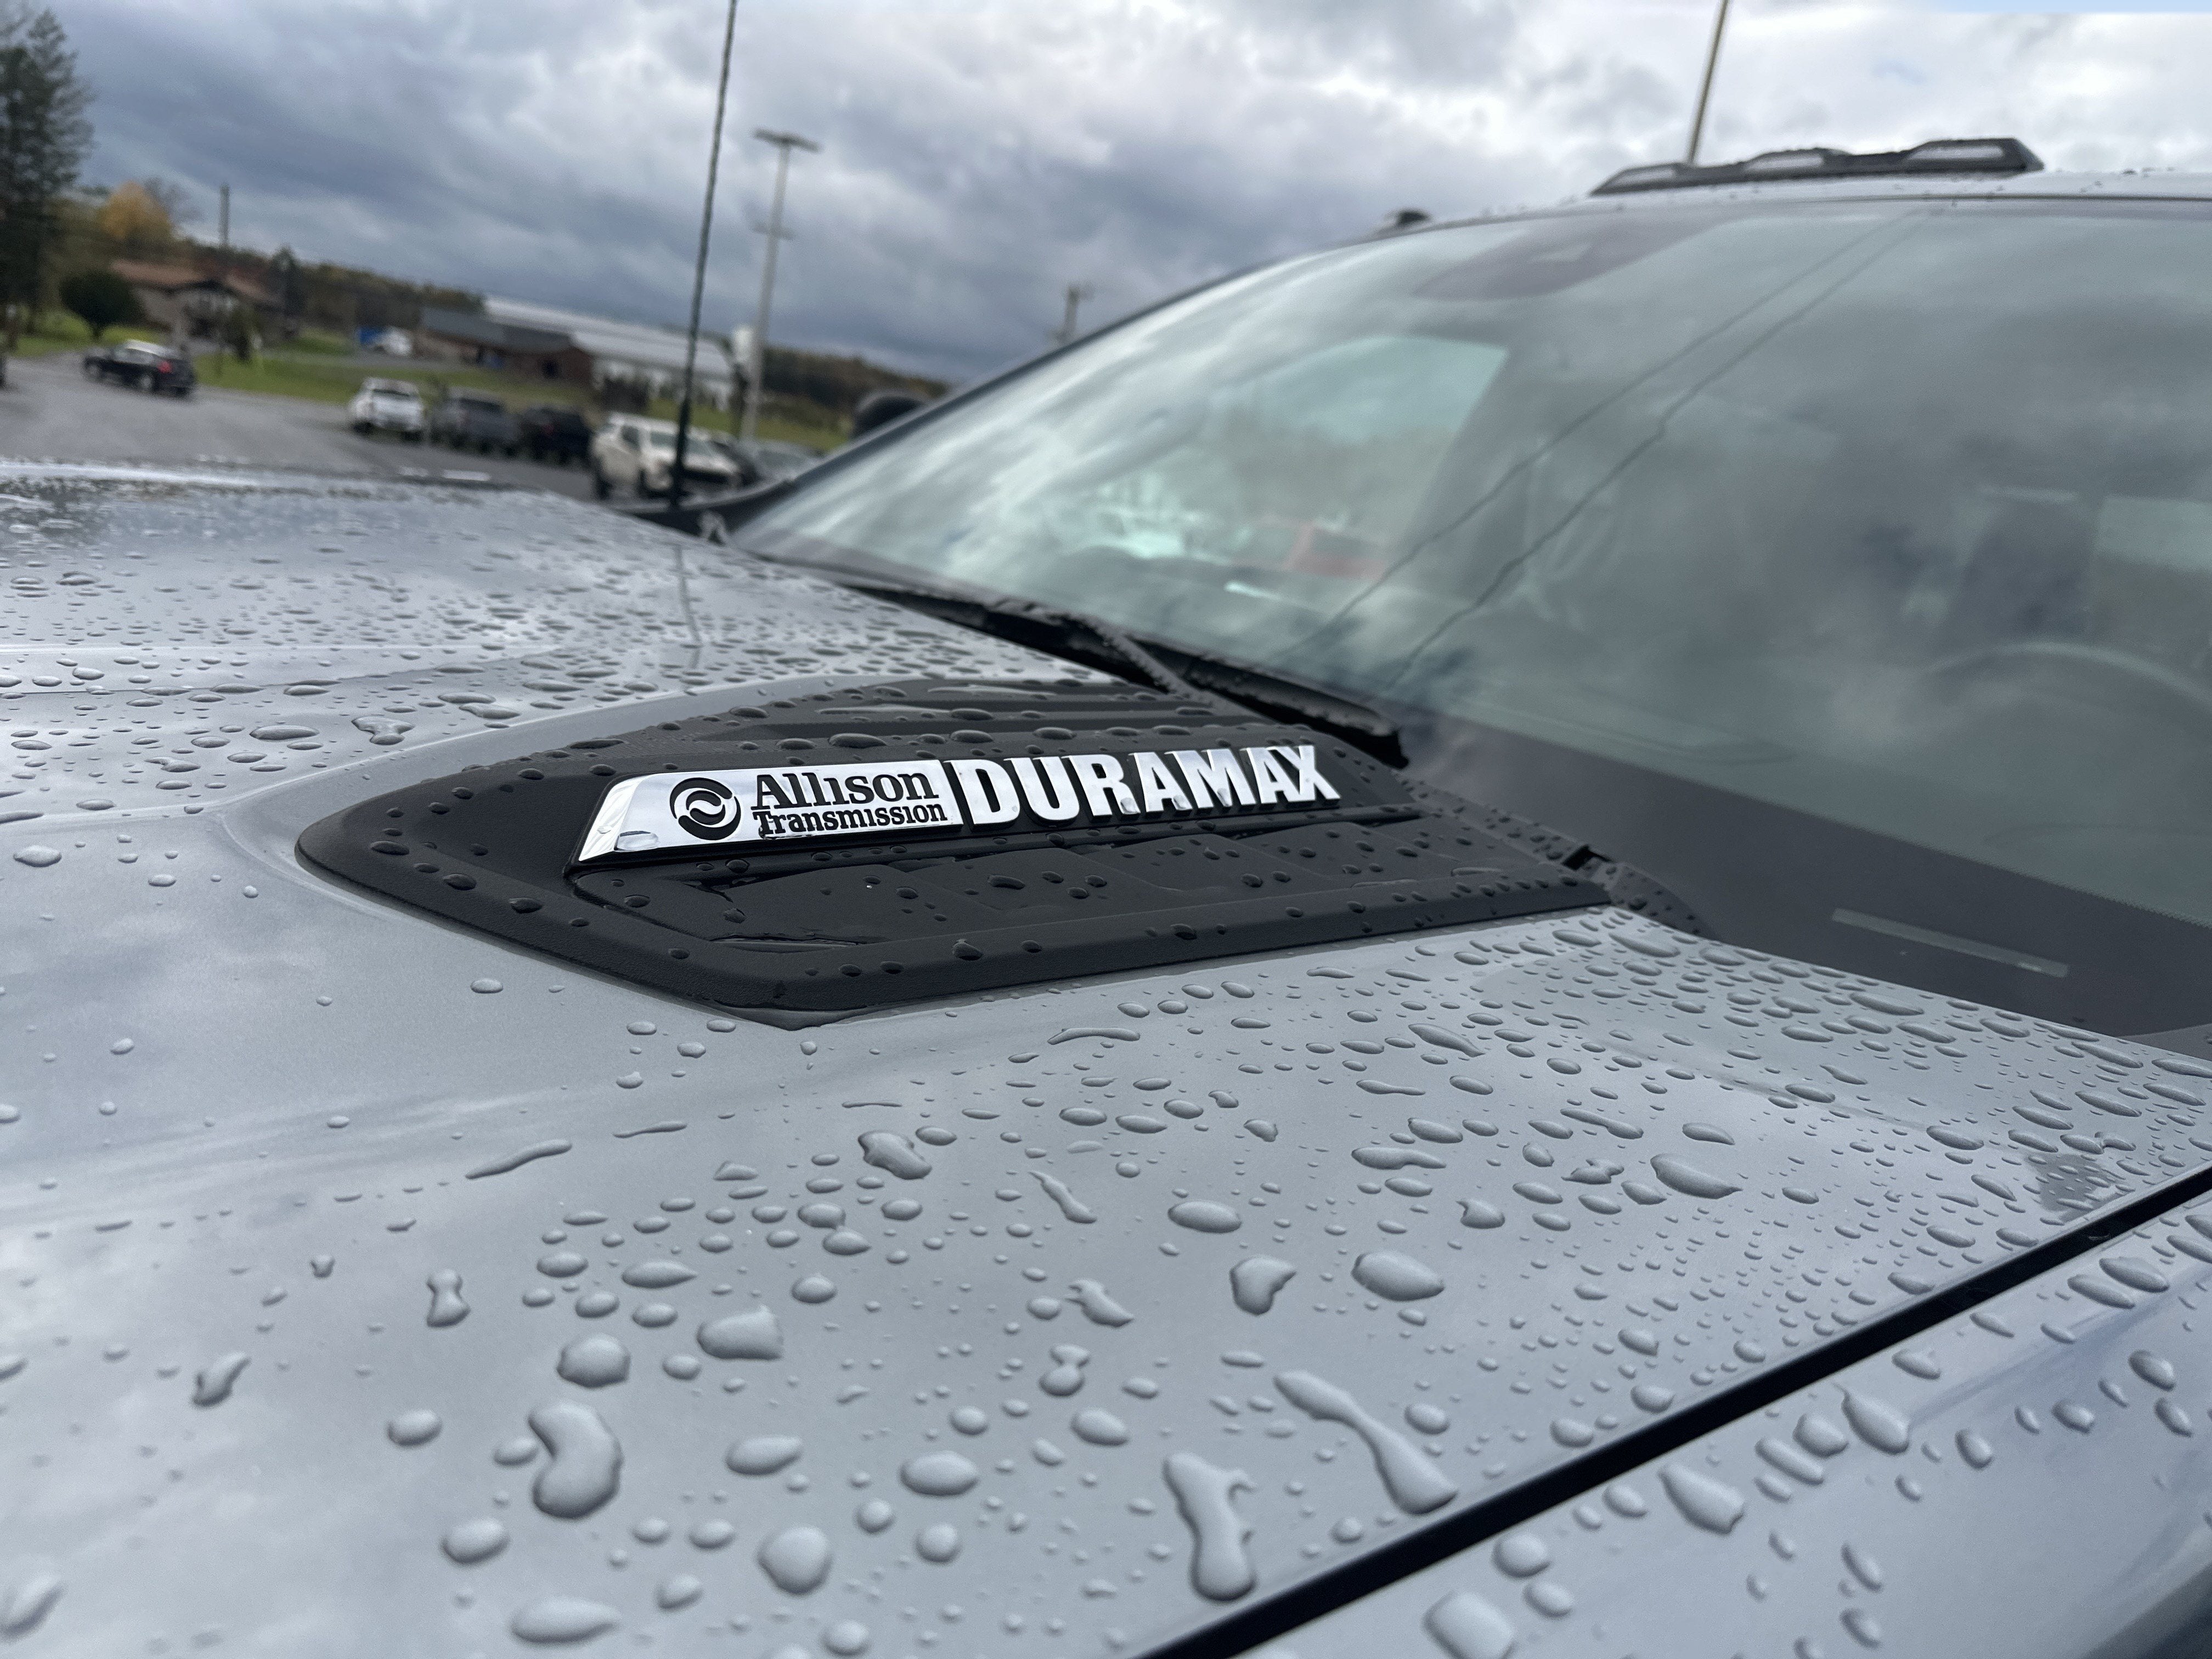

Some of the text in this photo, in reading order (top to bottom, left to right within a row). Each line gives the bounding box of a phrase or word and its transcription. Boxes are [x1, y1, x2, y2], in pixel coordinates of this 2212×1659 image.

[751, 772, 939, 809] Allison
[947, 745, 1341, 825] DURAMAX
[753, 804, 947, 834] Transmission
